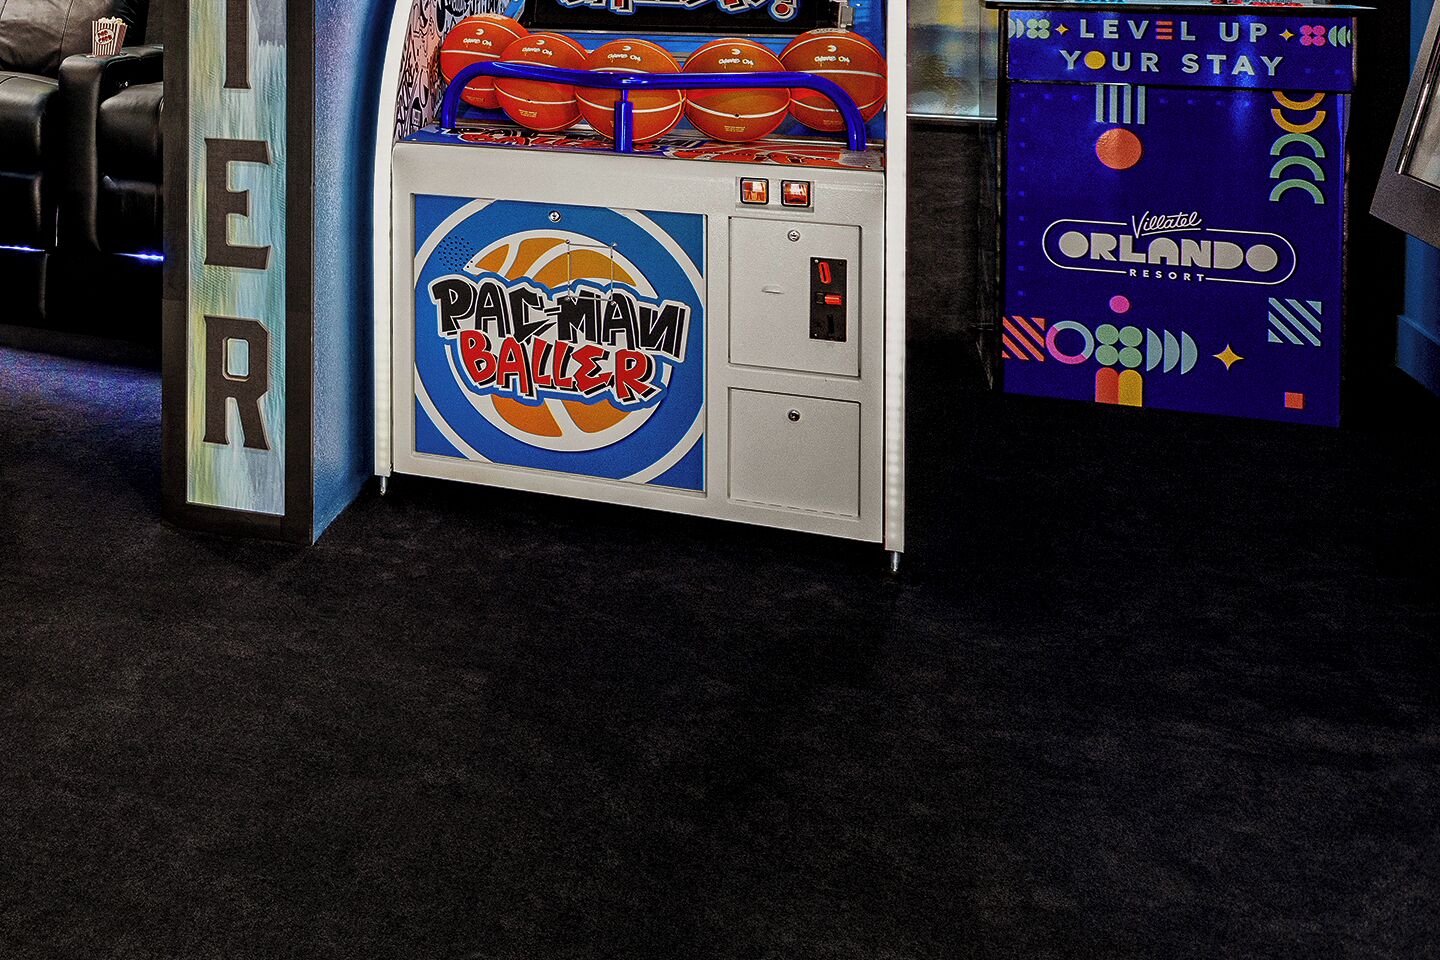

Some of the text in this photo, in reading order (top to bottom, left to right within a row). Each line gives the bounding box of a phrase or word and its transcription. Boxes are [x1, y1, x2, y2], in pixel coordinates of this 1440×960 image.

[1079, 19, 1268, 43] LEVEL UP
[1059, 50, 1284, 77] YOUR STAY
[1131, 211, 1202, 239] Villatel
[1058, 231, 1278, 273] ORLANDO
[1129, 268, 1206, 282] RESORT
[431, 280, 689, 362] PAC-MAN
[458, 330, 661, 402] BALLER
